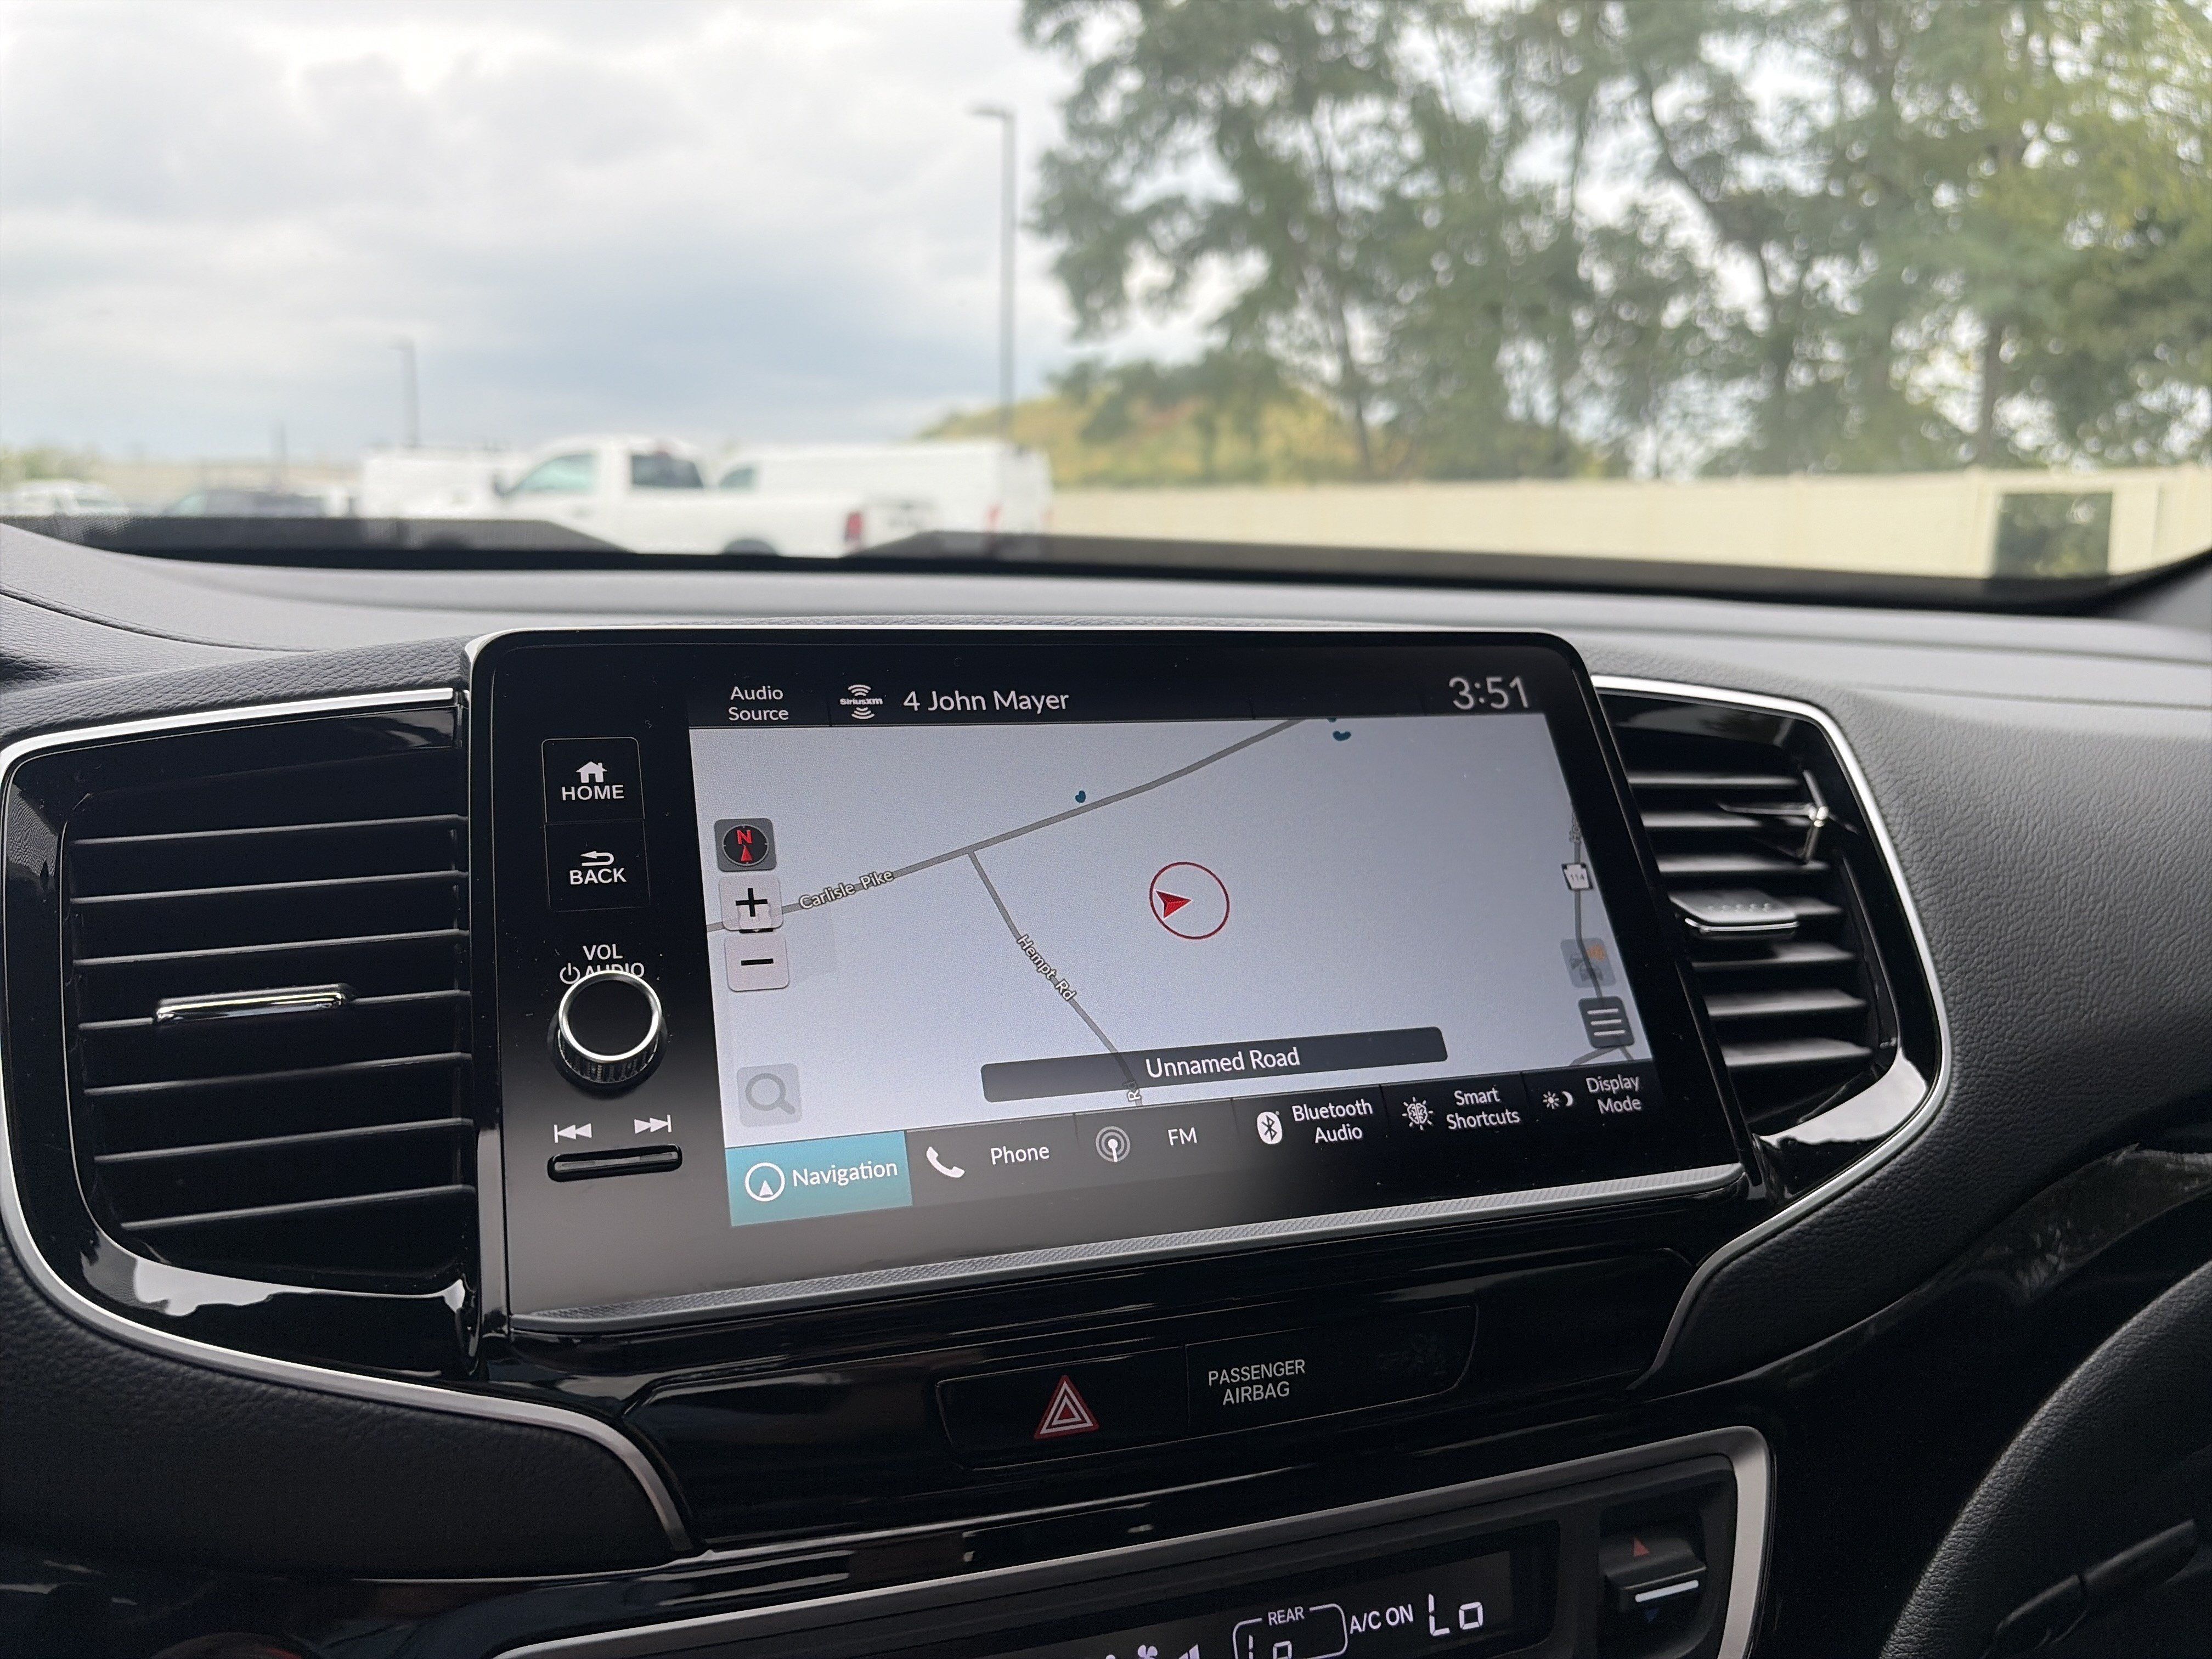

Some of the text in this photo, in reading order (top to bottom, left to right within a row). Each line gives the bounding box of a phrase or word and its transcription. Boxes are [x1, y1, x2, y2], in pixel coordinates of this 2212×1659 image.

[730, 685, 783, 701] Audio
[903, 690, 1069, 714] 4 John Mayer
[1449, 676, 1529, 709] 3:51
[729, 707, 789, 721] Source
[561, 784, 625, 801] HOME
[737, 830, 752, 844] N
[569, 867, 627, 885] BACK
[799, 871, 894, 909] Carlisle Pike
[582, 944, 623, 961] VOL
[1017, 935, 1076, 1001] Hempt Rd
[1146, 1046, 1300, 1079] Unnamed Road
[1585, 1074, 1639, 1094] Display
[1454, 1087, 1500, 1106] Smart
[1597, 1096, 1641, 1114] Mode
[1292, 1098, 1373, 1121] Bluetooth
[1446, 1109, 1520, 1130] Shortcuts
[1167, 1127, 1198, 1146] FM
[1314, 1123, 1363, 1143] Audio
[990, 1146, 1049, 1165] Phone
[792, 1160, 898, 1187] Navigation
[1208, 1358, 1306, 1386] PASSENGER
[1222, 1381, 1290, 1406] AIRBAG
[1268, 1606, 1305, 1626] REAR
[1350, 1604, 1414, 1634] A/C ON
